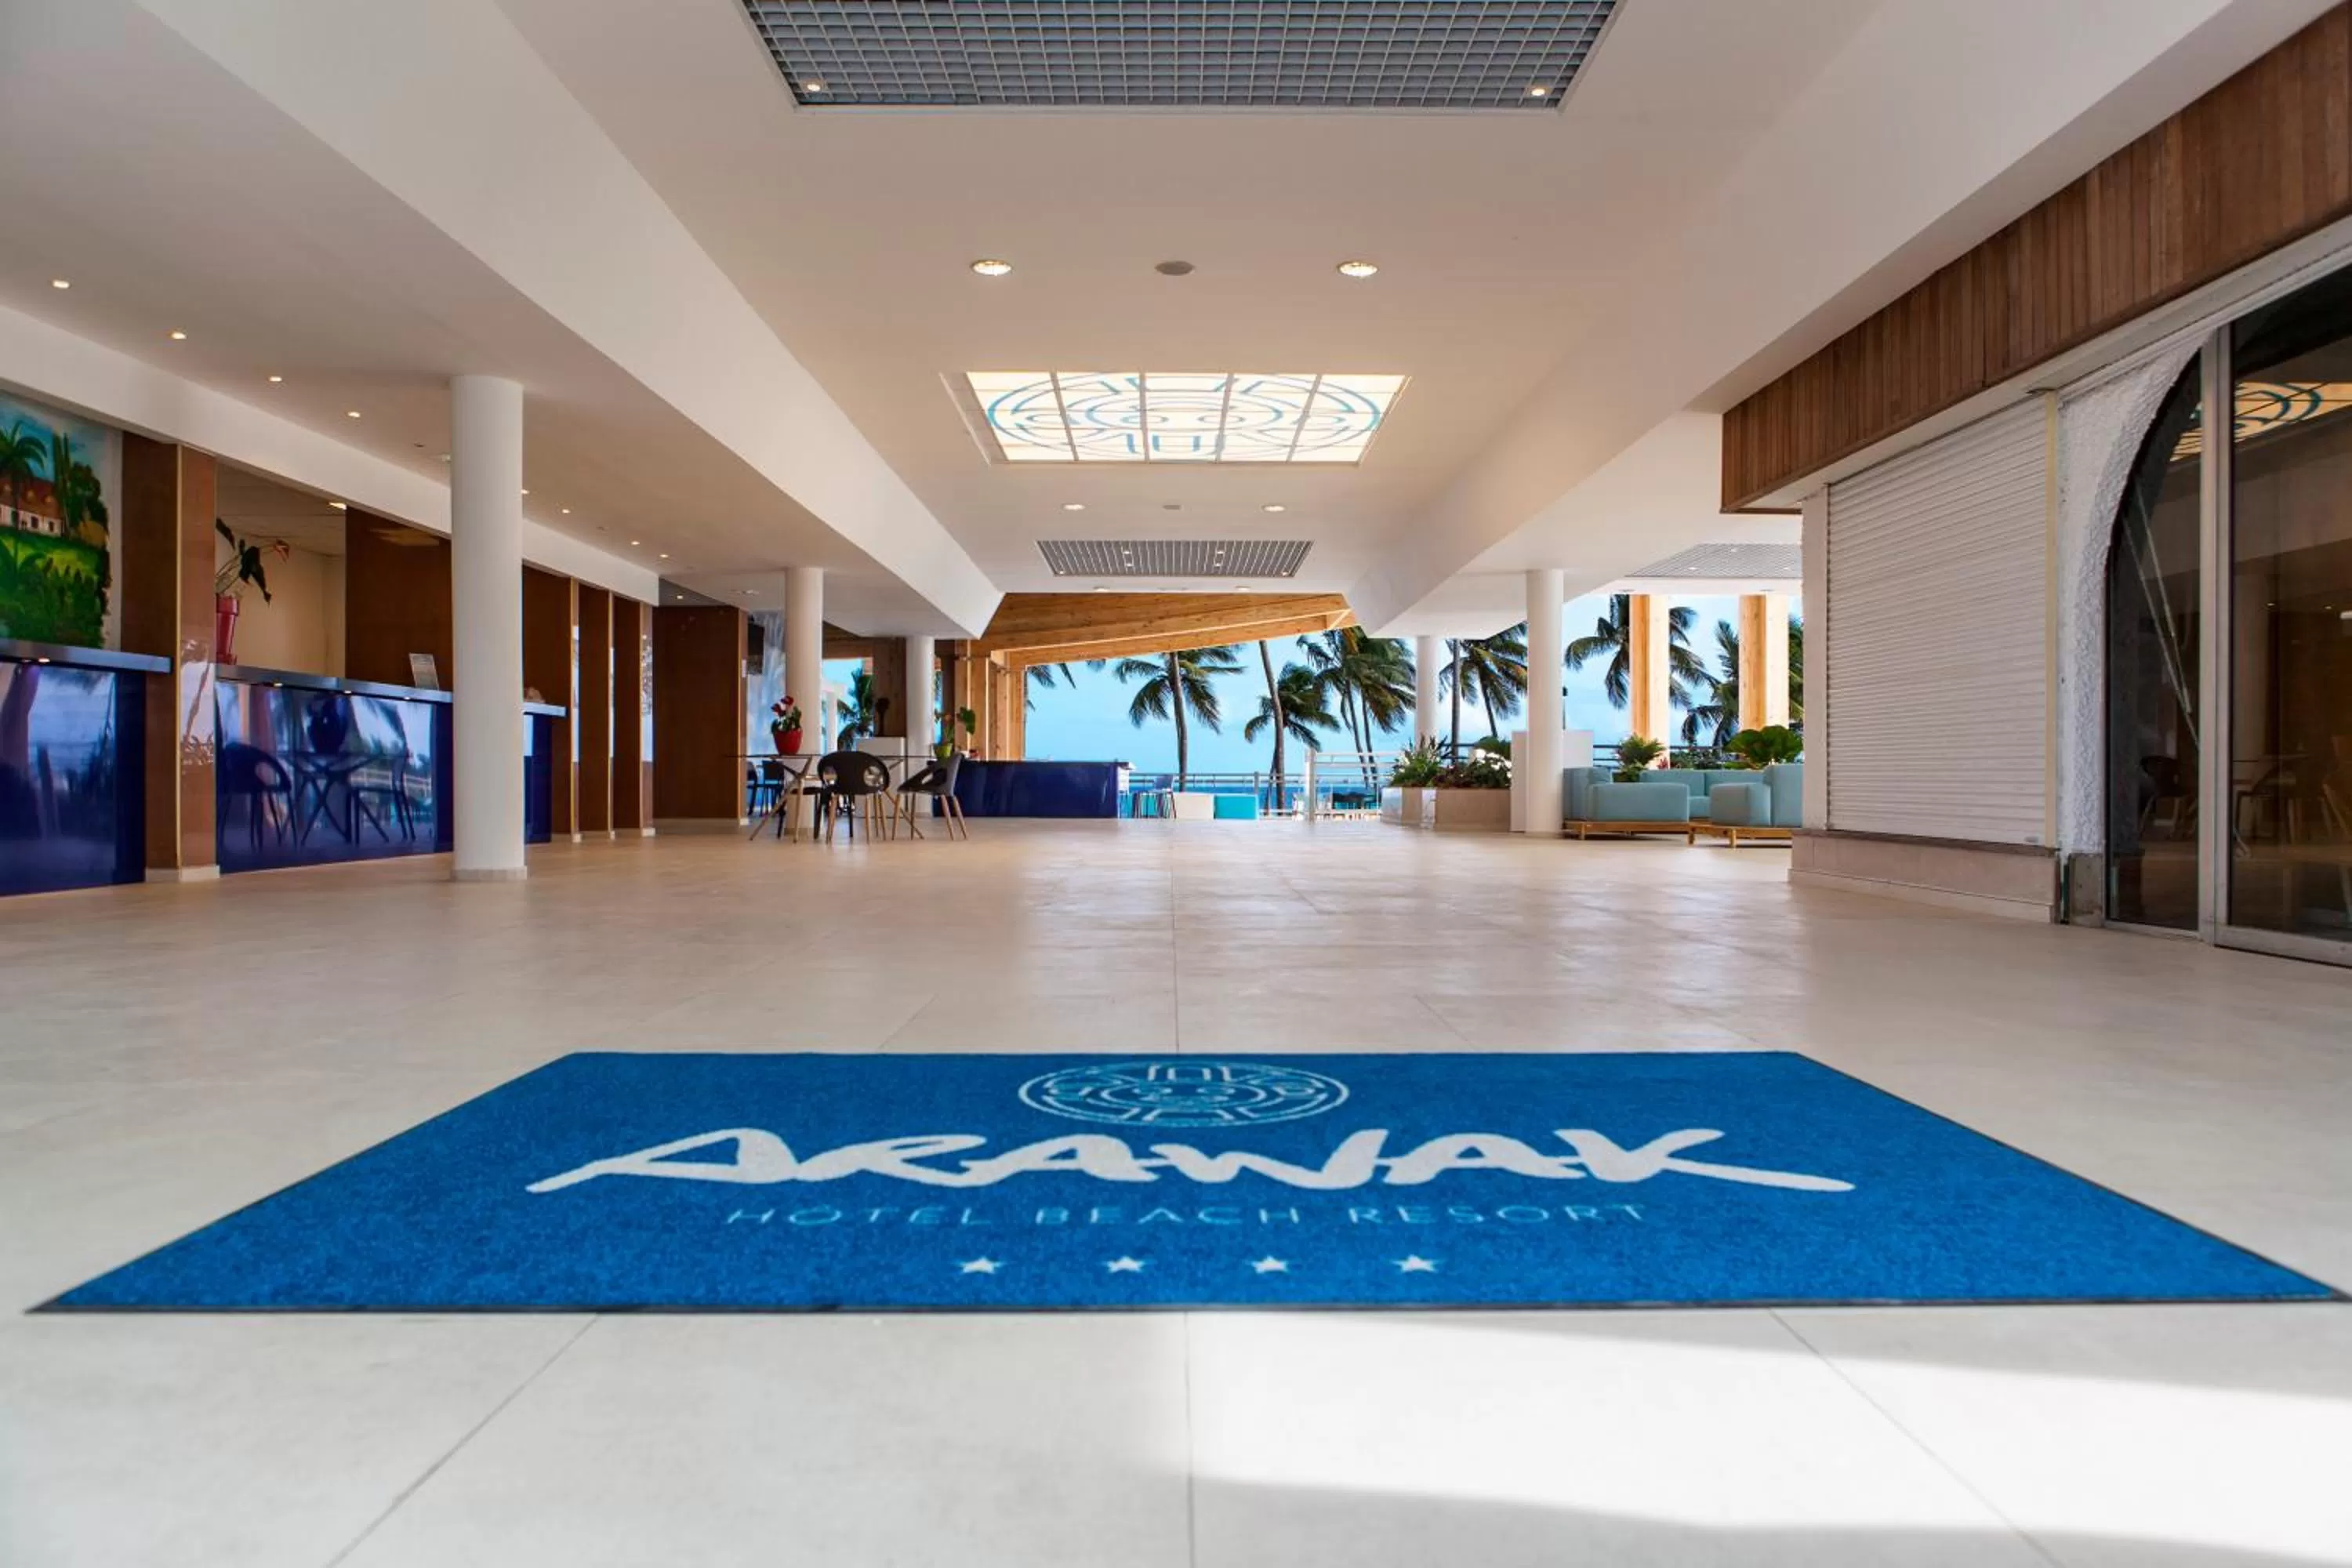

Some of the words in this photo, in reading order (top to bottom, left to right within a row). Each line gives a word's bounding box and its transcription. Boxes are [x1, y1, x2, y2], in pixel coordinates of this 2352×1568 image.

[526, 1127, 1855, 1192] ARAWAK
[1035, 1207, 1300, 1225] BEACH
[1348, 1204, 1644, 1224] RESORT
